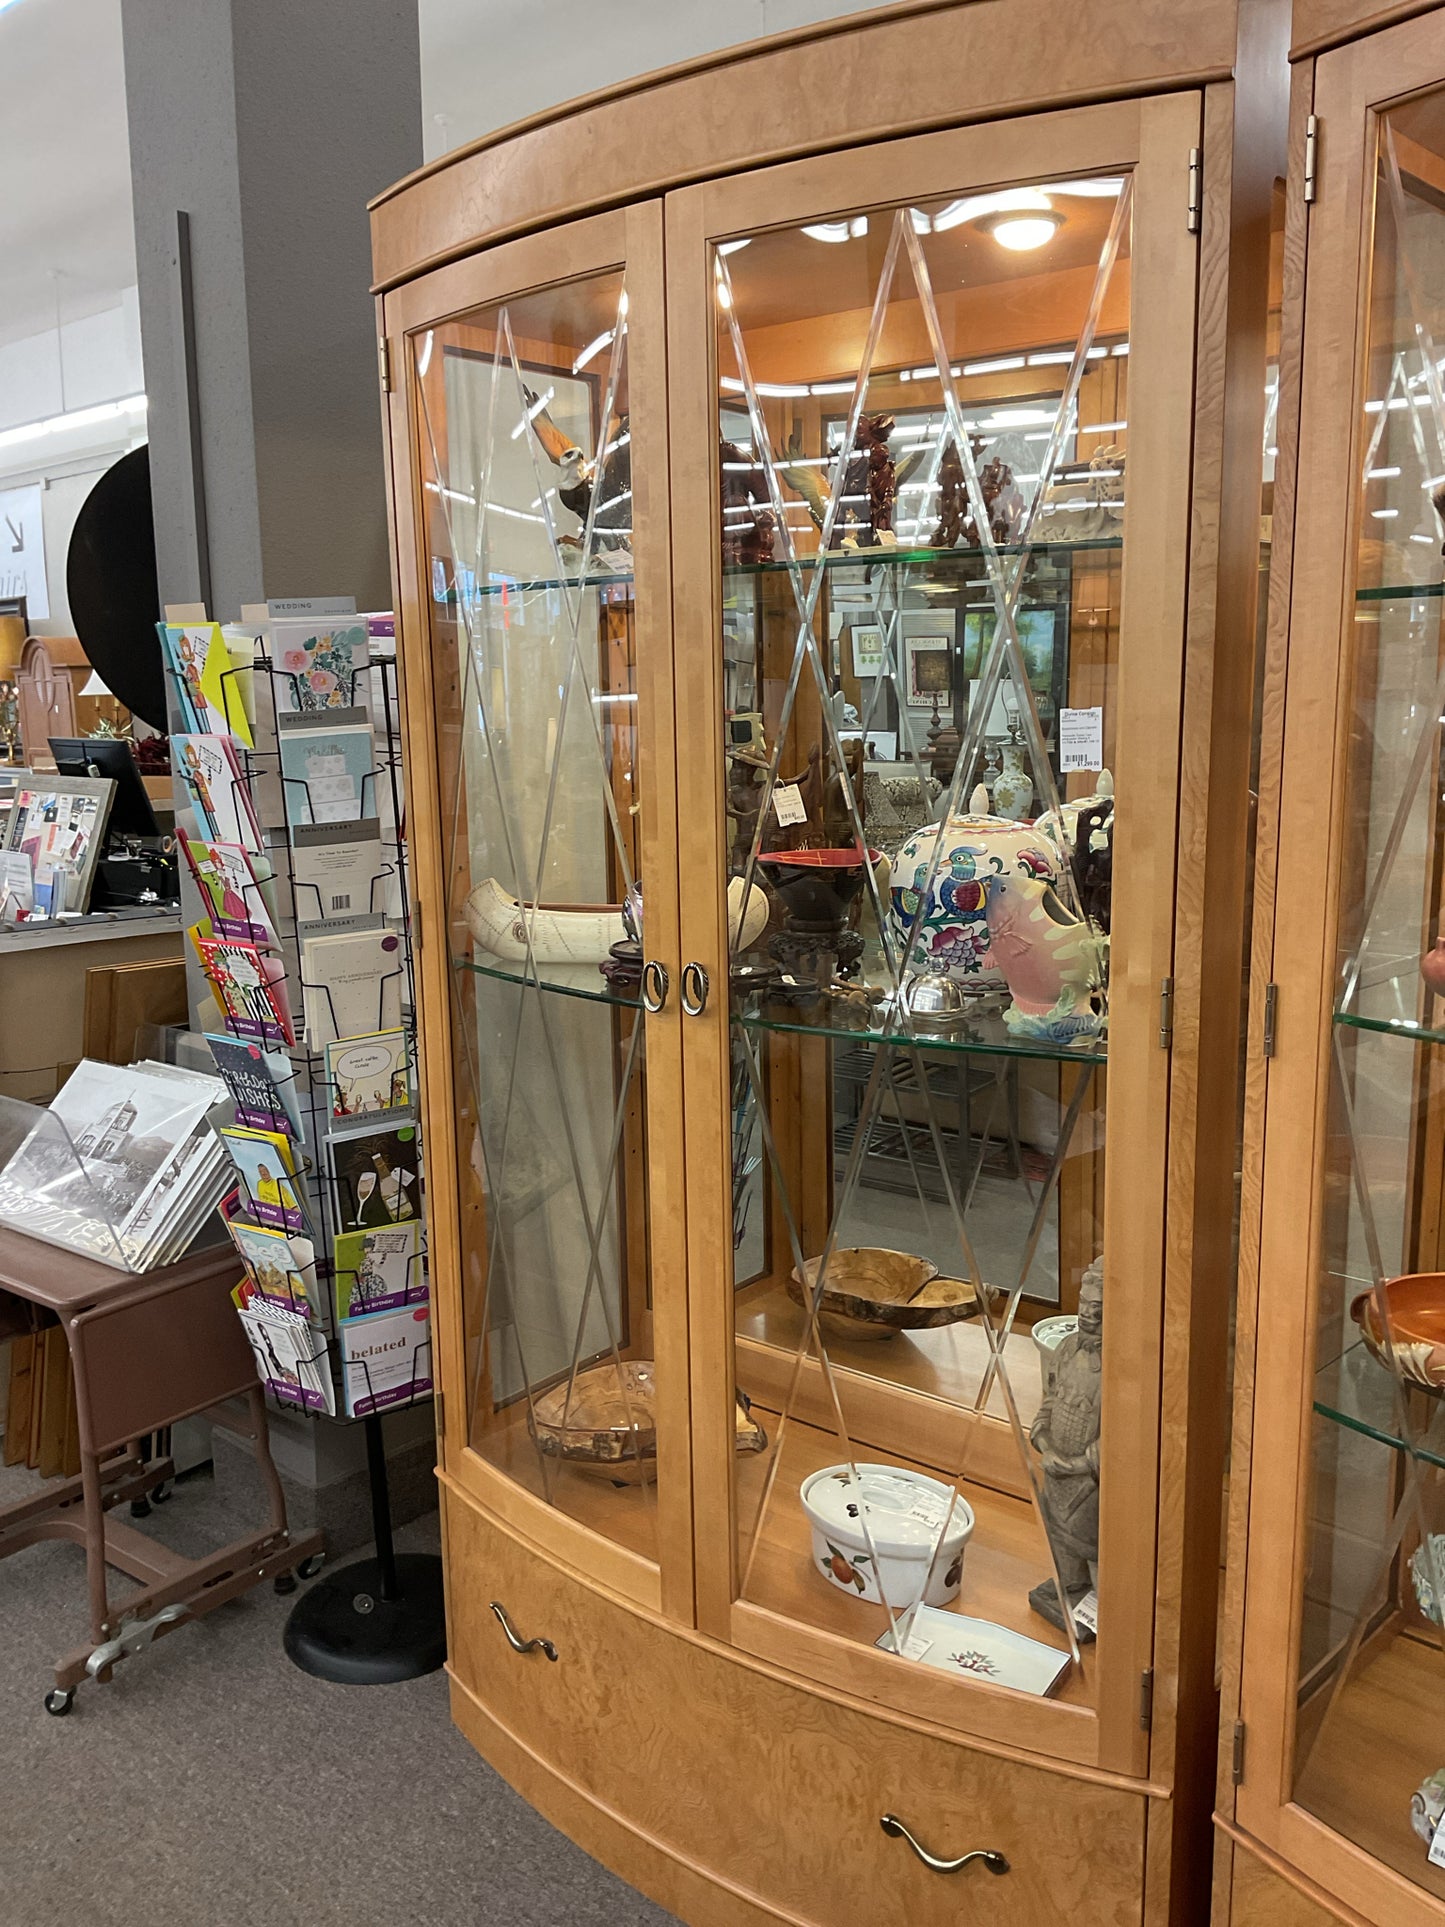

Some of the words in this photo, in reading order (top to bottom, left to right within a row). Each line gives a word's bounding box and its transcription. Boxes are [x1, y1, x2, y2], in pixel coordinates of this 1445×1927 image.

[274, 602, 312, 610] WEDDING
[285, 714, 323, 722] WEDDING
[300, 824, 353, 833] ANNIVERSARY
[303, 919, 356, 930] ANNIVERSARY
[336, 1107, 409, 1125] CONGRATULATIONS
[371, 1298, 395, 1308] Birthday
[351, 1336, 406, 1360] belated
